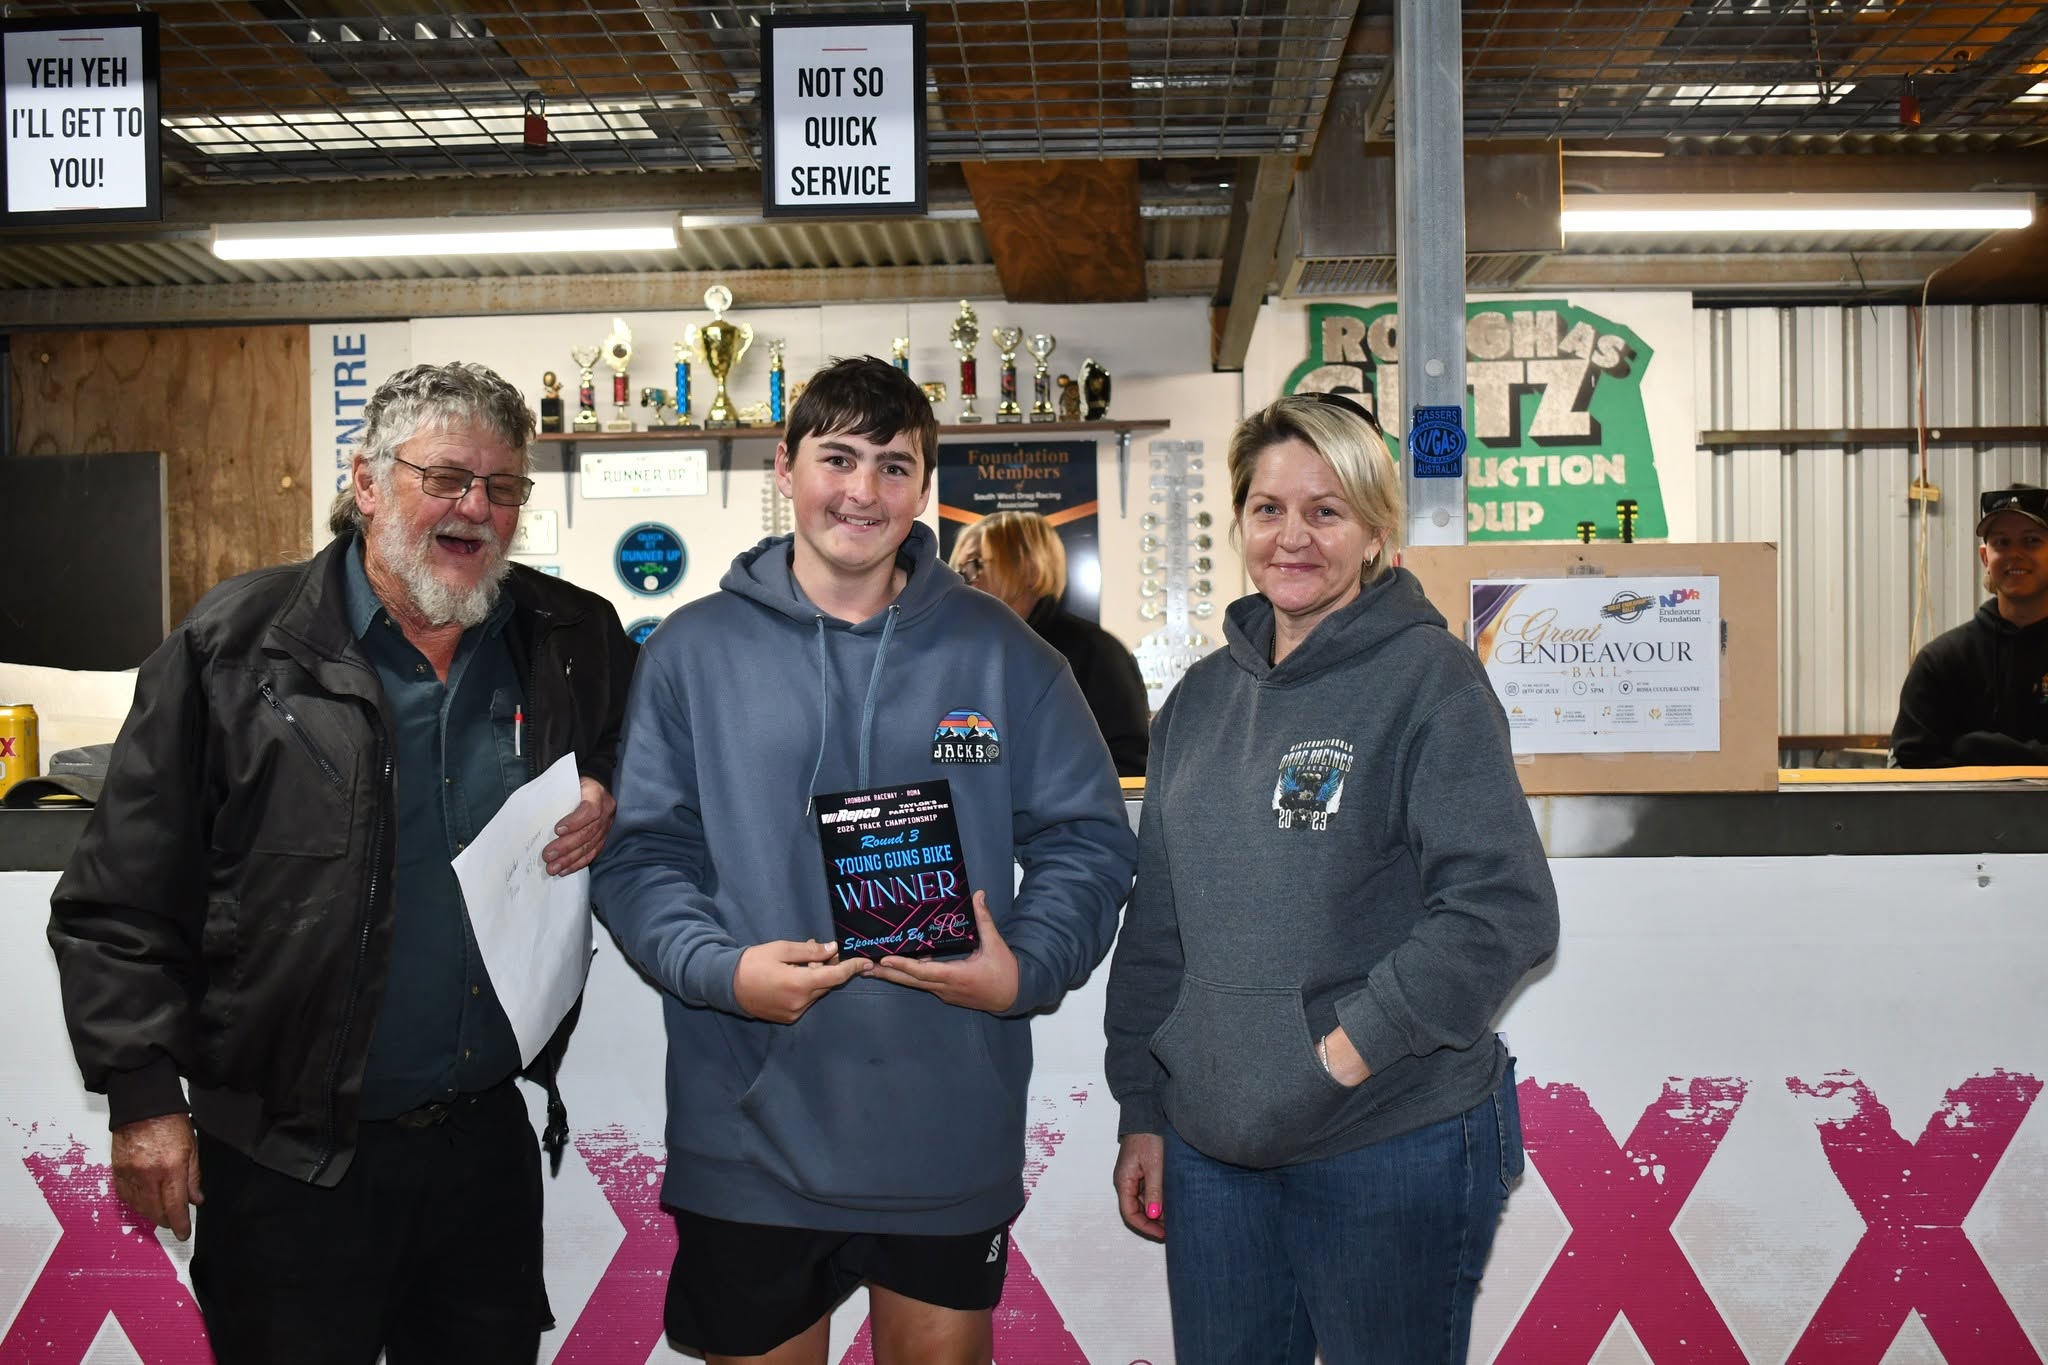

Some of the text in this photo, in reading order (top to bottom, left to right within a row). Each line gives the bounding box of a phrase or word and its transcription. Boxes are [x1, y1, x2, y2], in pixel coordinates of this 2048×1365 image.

[27, 57, 127, 89] YEH YEH
[798, 66, 884, 98] NOT SO
[13, 107, 142, 139] I'LL GET TO
[805, 116, 877, 149] QUICK
[50, 157, 104, 188] YOU!
[791, 165, 891, 197] SERVICE
[1322, 310, 1627, 370] ROGH AS
[1416, 410, 1458, 423] GASSERS
[1418, 429, 1457, 456] V/GAS
[968, 448, 1070, 465] Foundation
[603, 468, 686, 483] RUNNER UP
[977, 464, 1061, 480] Members
[1416, 462, 1459, 475] AUSTRALIA
[1467, 454, 1627, 487] UCTION
[973, 491, 1062, 502] South West Drag Racing
[996, 501, 1039, 509] Association
[1467, 502, 1545, 533] OUP
[621, 550, 681, 562] RUNNER UP
[1659, 608, 1701, 616] Endeavour
[1503, 608, 1603, 648] Great
[1519, 641, 1694, 664] ENDEAVOUR
[1572, 666, 1621, 678] BALL
[933, 743, 984, 759] JACKS
[1278, 748, 1354, 773] DRAG RACINGS
[844, 795, 872, 805] IRONBARK
[873, 791, 898, 801] RACEWAY
[906, 788, 921, 797] ROMA
[899, 799, 938, 809] TAYLOR'S
[836, 807, 881, 823] Repco
[888, 803, 949, 816] PARTS CENTRE
[1278, 808, 1328, 831] 20 23
[836, 813, 938, 834] 2026 TRACK CHAMPIONSHIP
[860, 829, 920, 850] Round 3
[835, 844, 953, 876] YOUNG GUNS BIKE
[835, 869, 959, 912] WINNER
[843, 927, 926, 951] Sponsored By
